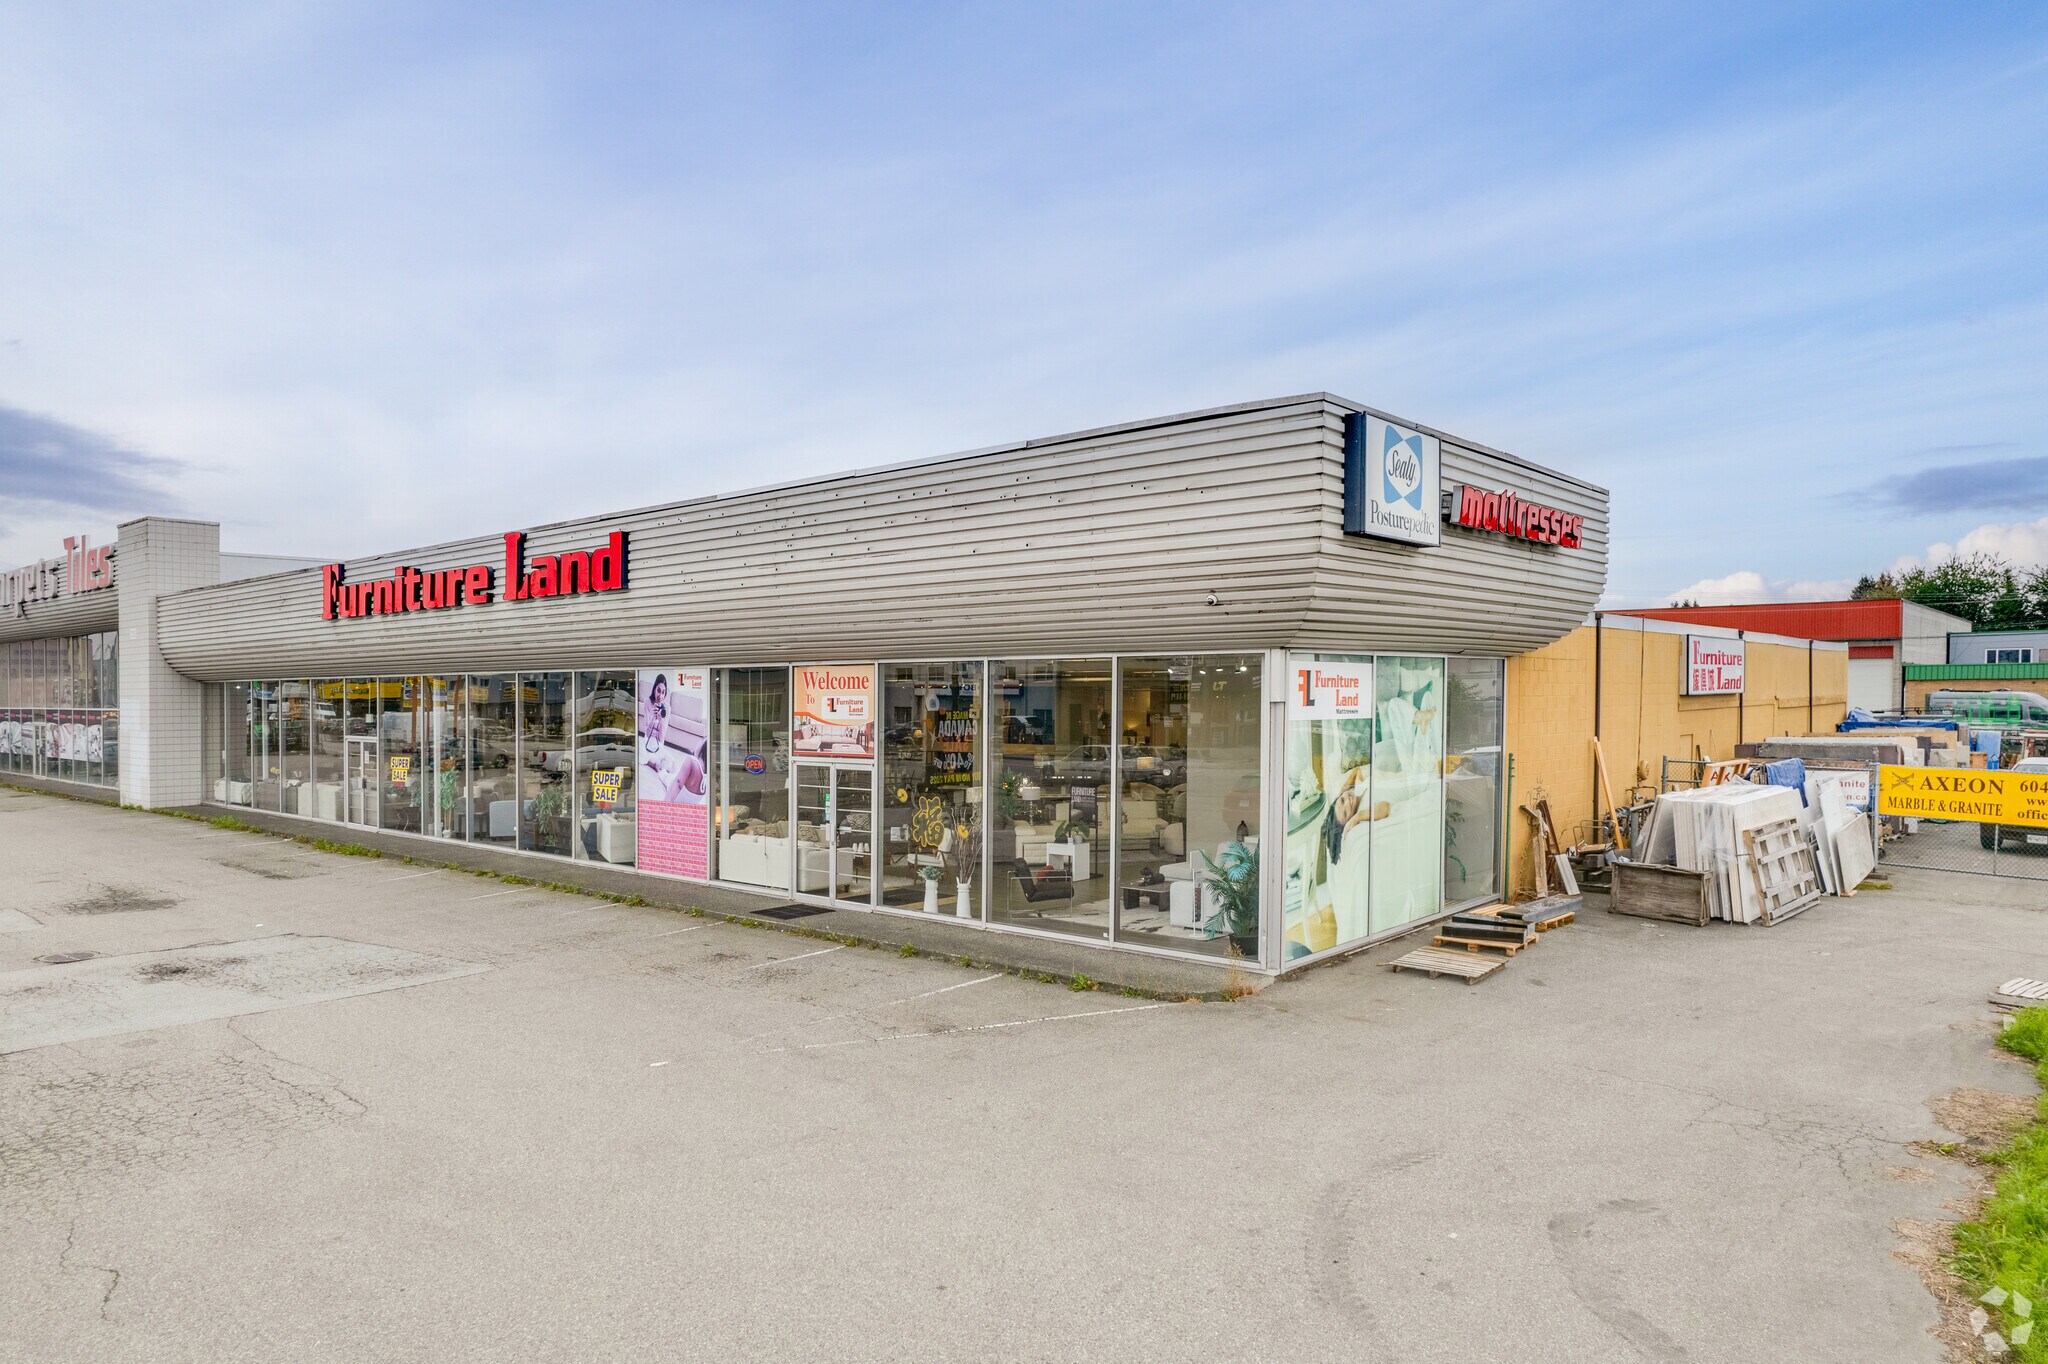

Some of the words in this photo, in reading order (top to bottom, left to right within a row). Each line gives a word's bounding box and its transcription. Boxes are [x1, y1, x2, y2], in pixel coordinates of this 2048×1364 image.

[1388, 450, 1416, 487] Sealy
[1371, 499, 1435, 537] Posturepedic
[1459, 485, 1584, 549] mattresses
[63, 535, 114, 593] Tiles
[322, 563, 494, 620] Furniture
[503, 531, 629, 600] Land
[1693, 640, 1742, 666] Furniture
[803, 671, 870, 690] Welcome
[1315, 670, 1359, 688] Furniture
[1717, 667, 1742, 690] Land
[806, 694, 815, 704] To
[1336, 689, 1359, 707] Land
[849, 705, 864, 713] Land
[392, 757, 409, 769] SUPER
[746, 760, 763, 769] OPEN
[393, 770, 406, 781] SALE
[593, 772, 620, 786] SUPER
[1071, 786, 1096, 796] FURNITURE
[1920, 775, 2005, 795] AXEON
[2019, 779, 2048, 794] 604
[595, 788, 616, 801] SALE
[1888, 796, 1935, 812] MARBLE
[1937, 799, 1946, 812] &
[1949, 799, 2003, 817] GRANITE
[2017, 809, 2048, 821] offic
